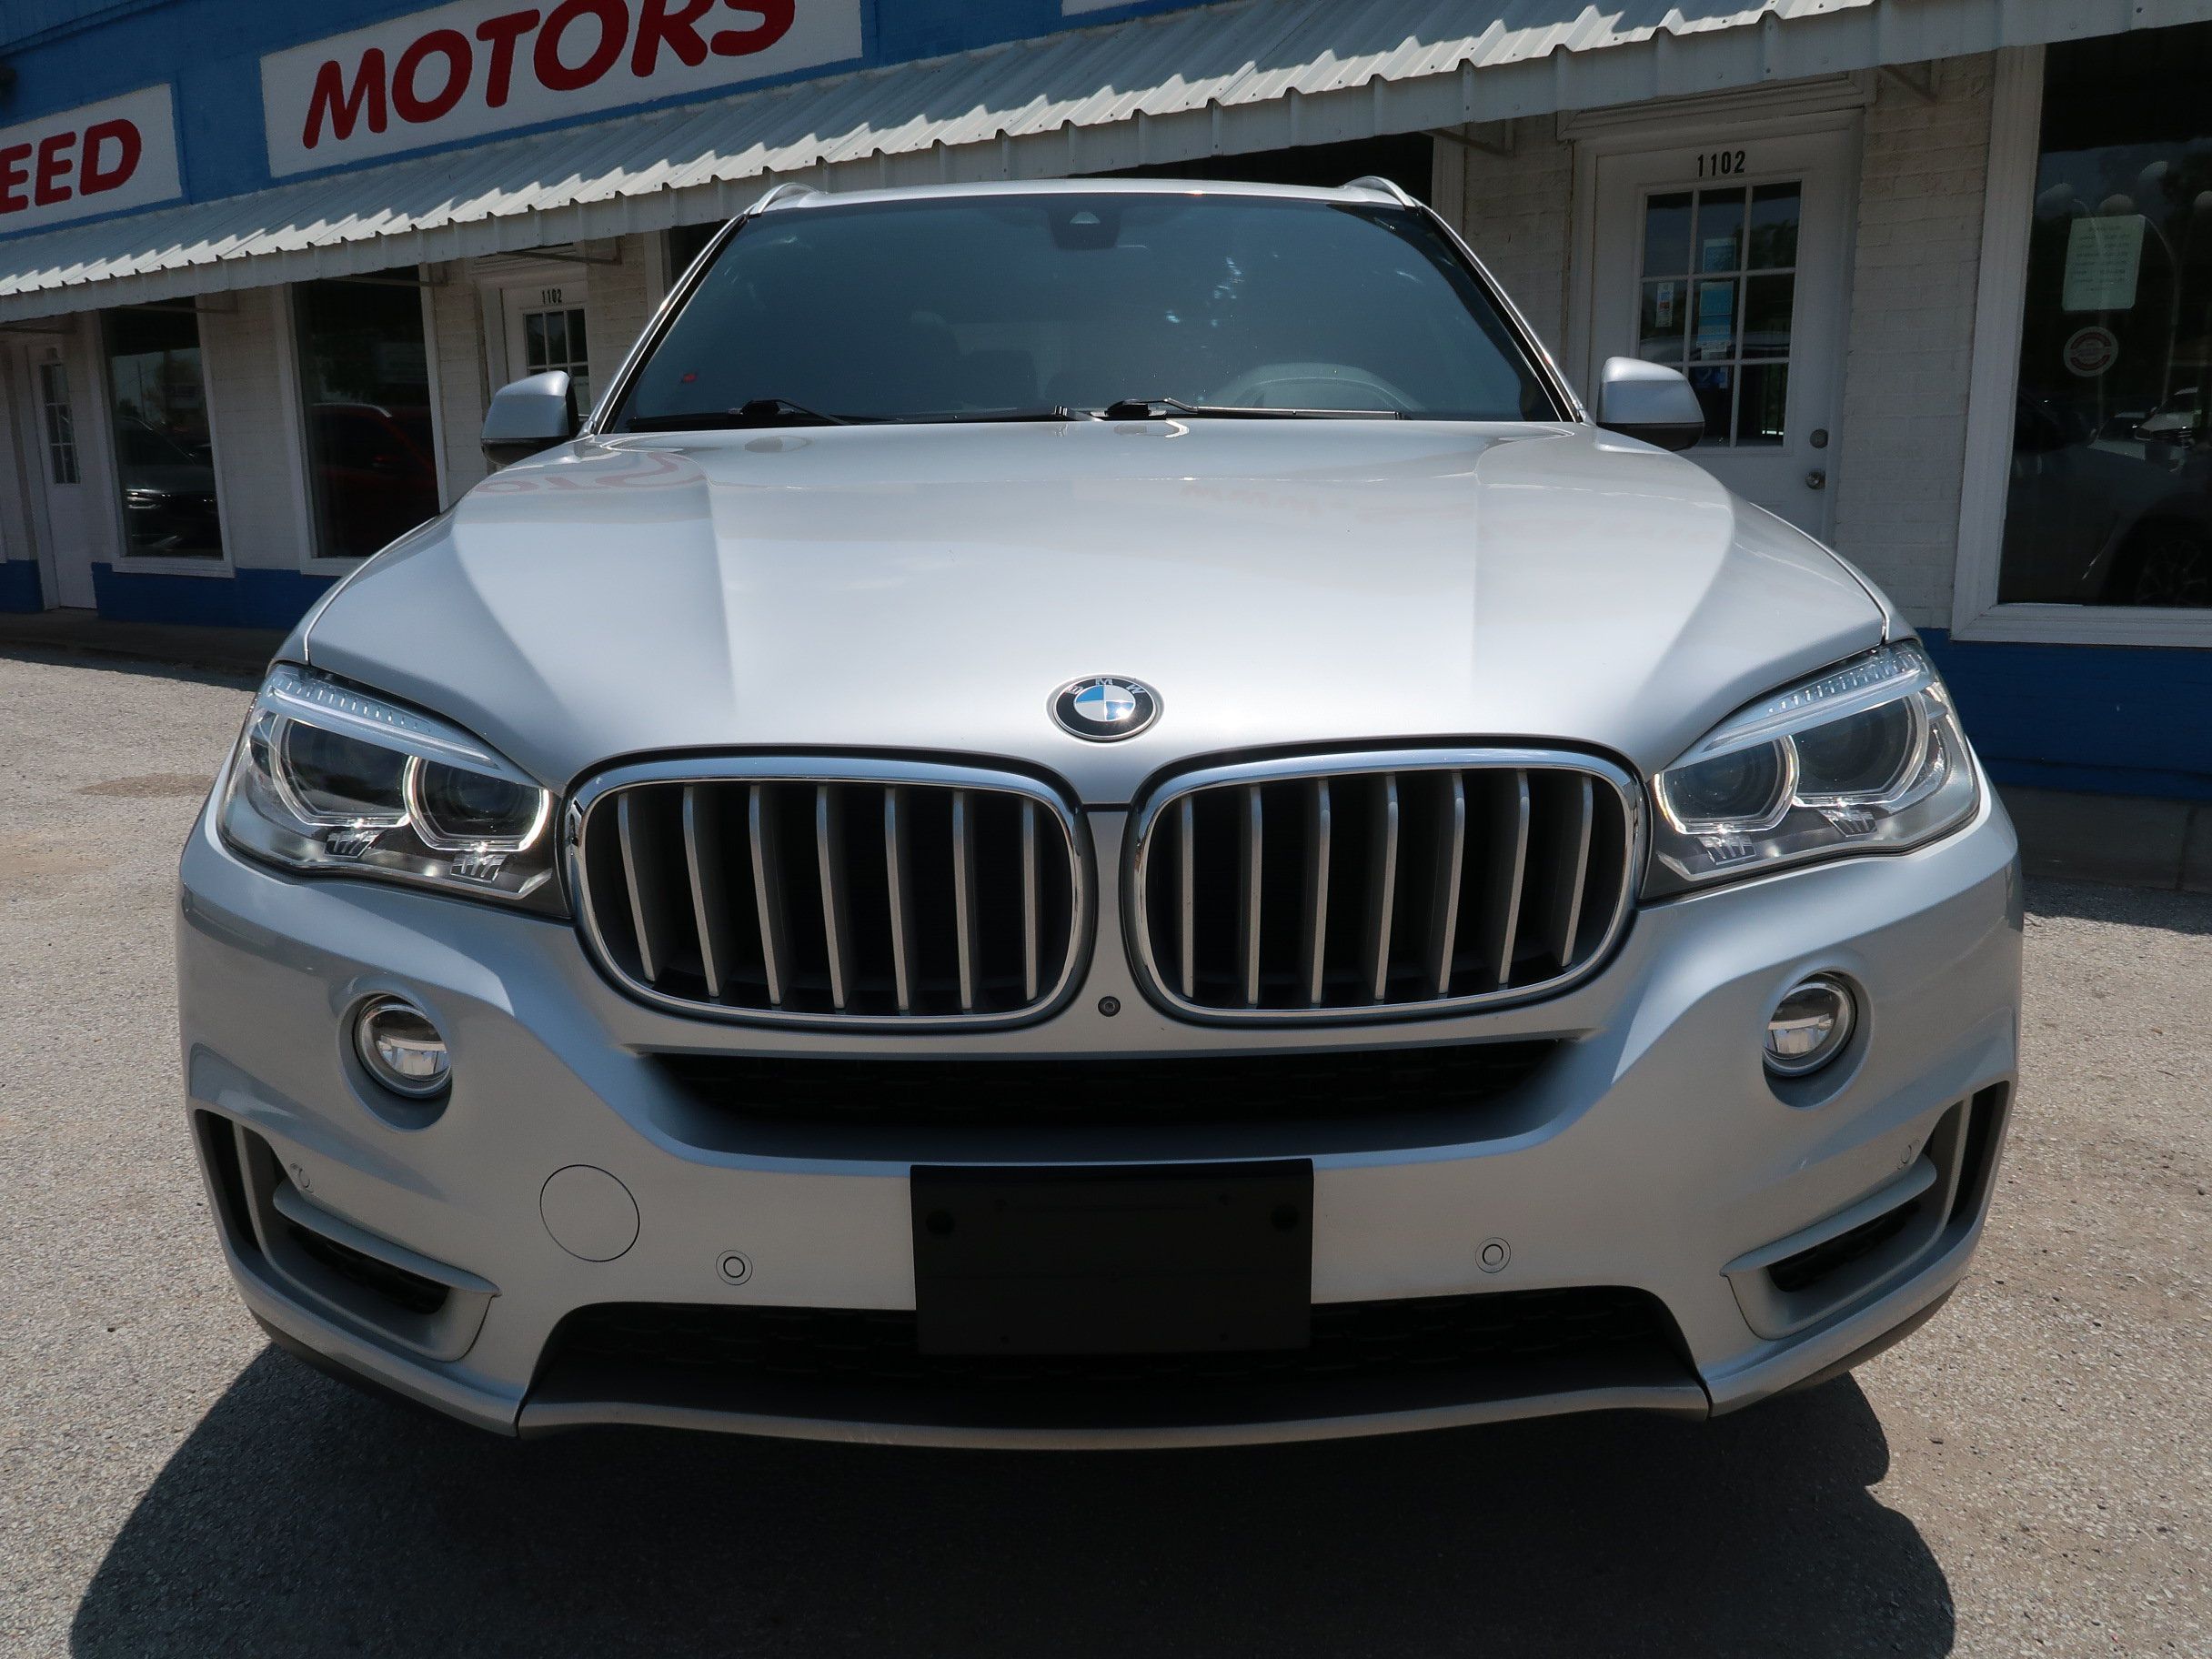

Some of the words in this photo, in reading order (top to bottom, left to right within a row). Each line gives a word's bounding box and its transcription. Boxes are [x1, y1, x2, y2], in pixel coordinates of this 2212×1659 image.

[302, 0, 796, 149] MOTORS
[1697, 150, 1746, 177] 1102
[542, 288, 562, 305] 1102
[1067, 678, 1145, 695] BMW
